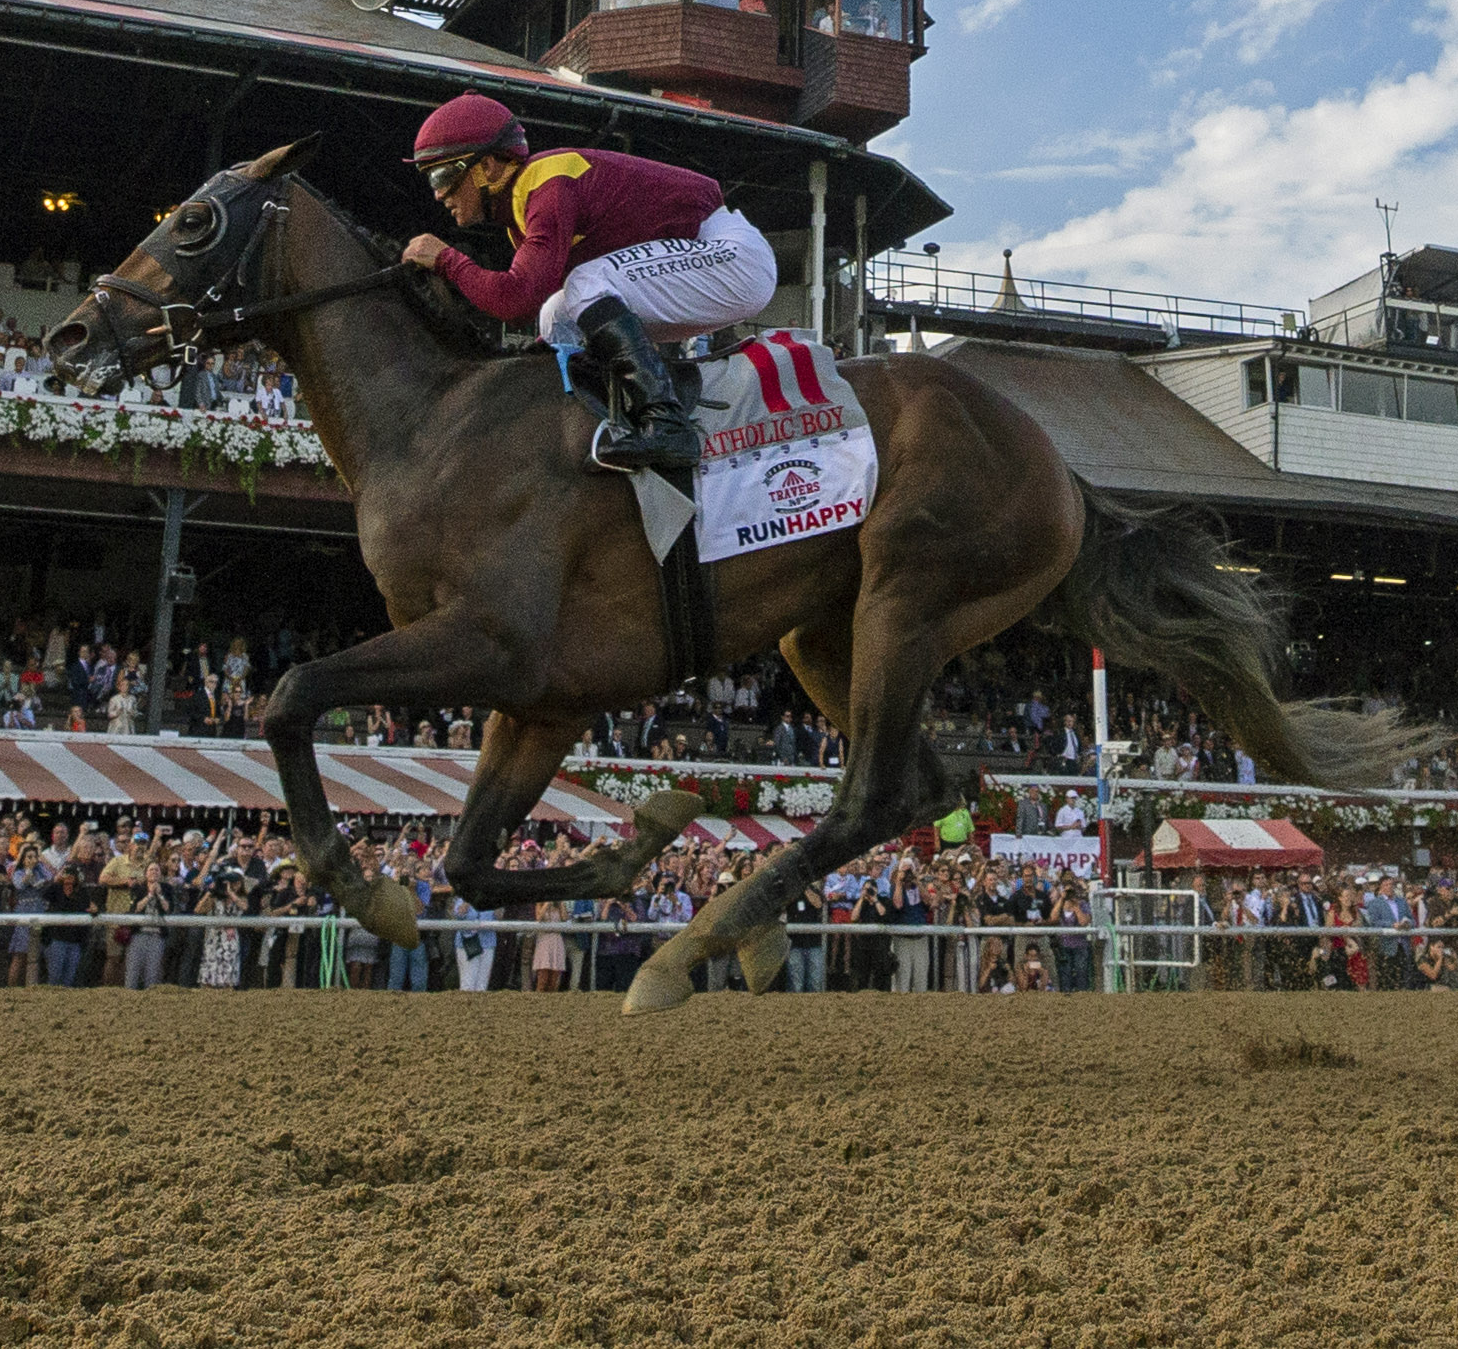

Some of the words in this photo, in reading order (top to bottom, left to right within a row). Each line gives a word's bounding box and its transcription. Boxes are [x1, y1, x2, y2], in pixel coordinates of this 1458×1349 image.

[605, 242, 655, 271] JEFF
[740, 330, 833, 414] 11
[701, 417, 795, 459] ATHOLIC
[799, 405, 845, 436] BOY
[768, 481, 821, 502] TRAVERS
[735, 497, 864, 547] RUNHAPPY
